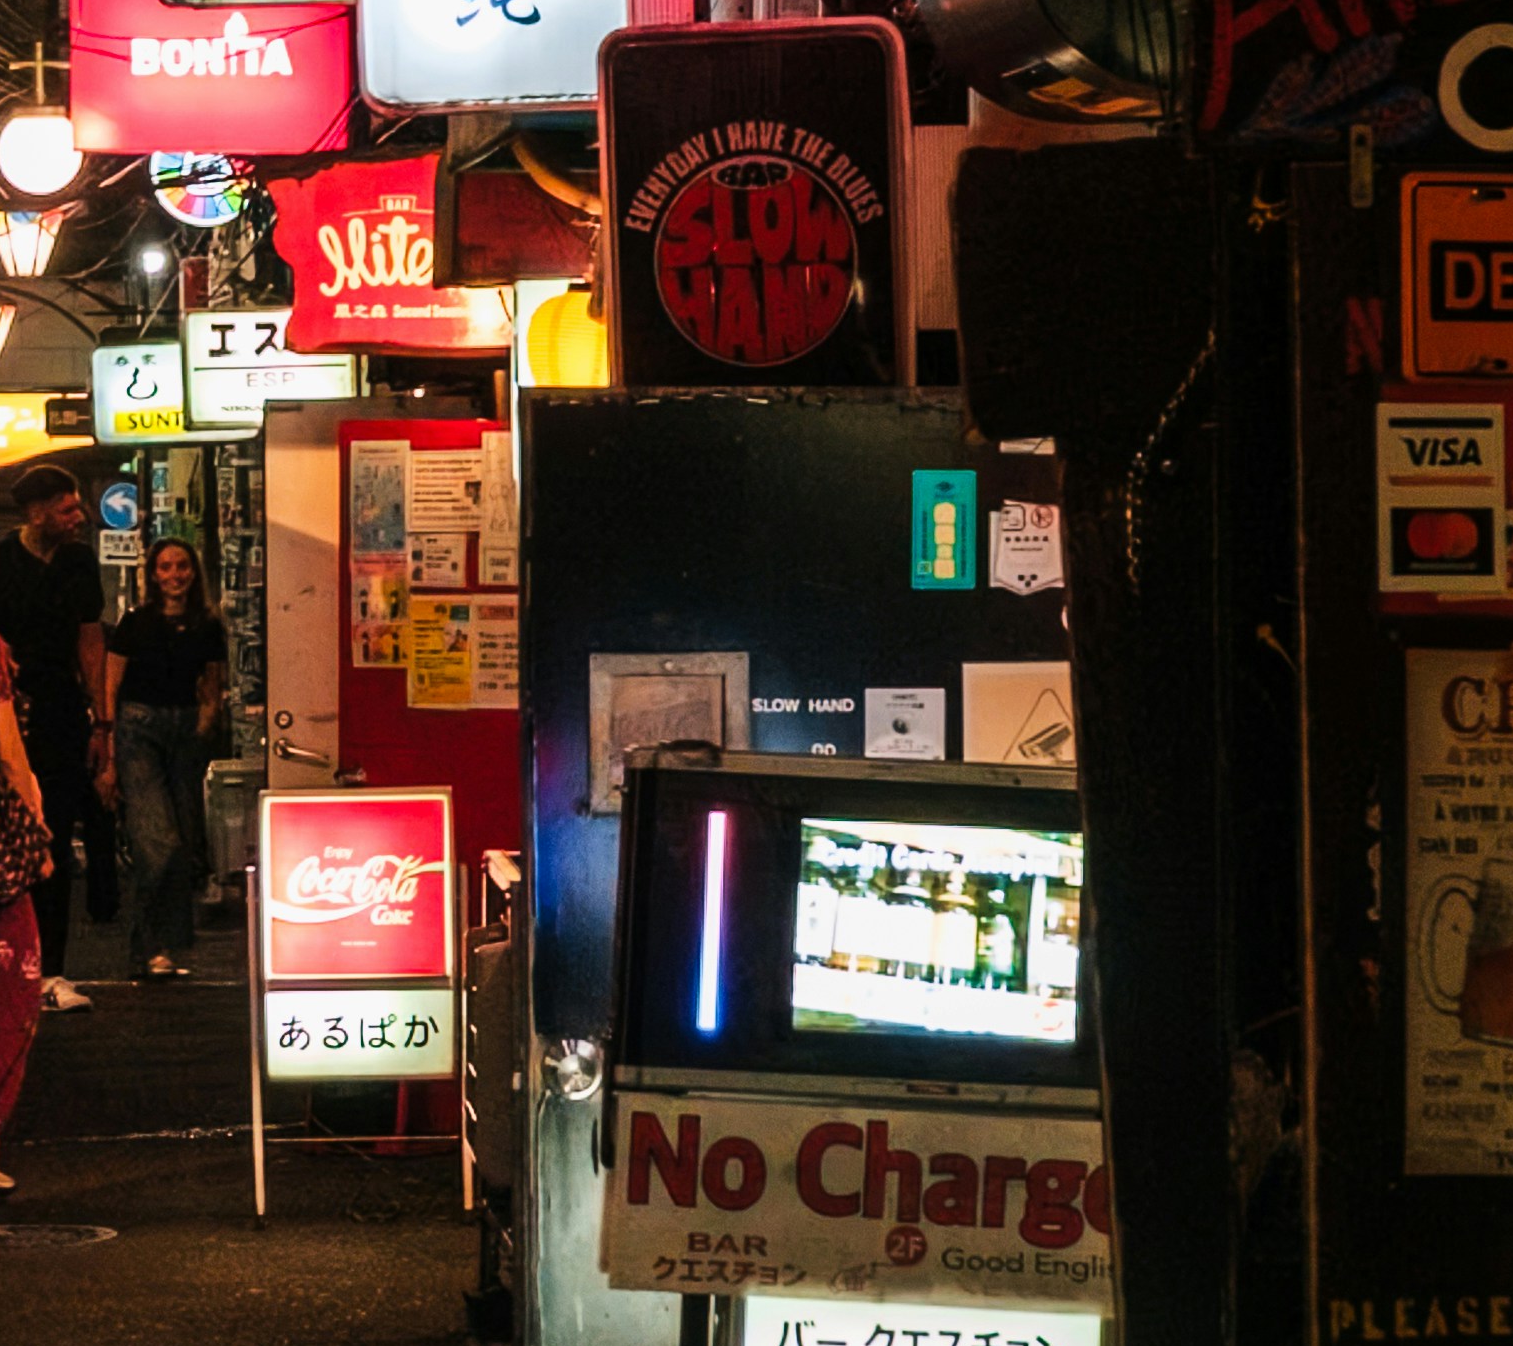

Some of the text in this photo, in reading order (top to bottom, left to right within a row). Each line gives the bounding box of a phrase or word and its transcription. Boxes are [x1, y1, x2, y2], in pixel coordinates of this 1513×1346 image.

[727, 120, 788, 151] HAVE
[790, 127, 835, 169] THE
[827, 153, 885, 225] BLUES
[387, 198, 409, 211] BAR
[662, 170, 851, 265] SLOW
[662, 264, 853, 364] HAND
[1403, 438, 1482, 465] VISA
[752, 698, 854, 713] SLOW HAND
[324, 847, 352, 861] Enjoy
[279, 1014, 439, 1050] あるぱか
[627, 1112, 767, 1211] No
[688, 1234, 768, 1257] BAR
[890, 1235, 923, 1257] 2F
[653, 1256, 806, 1286] クエスチョン
[941, 1248, 1024, 1275] Good
[1329, 1295, 1513, 1343] PLEASE
